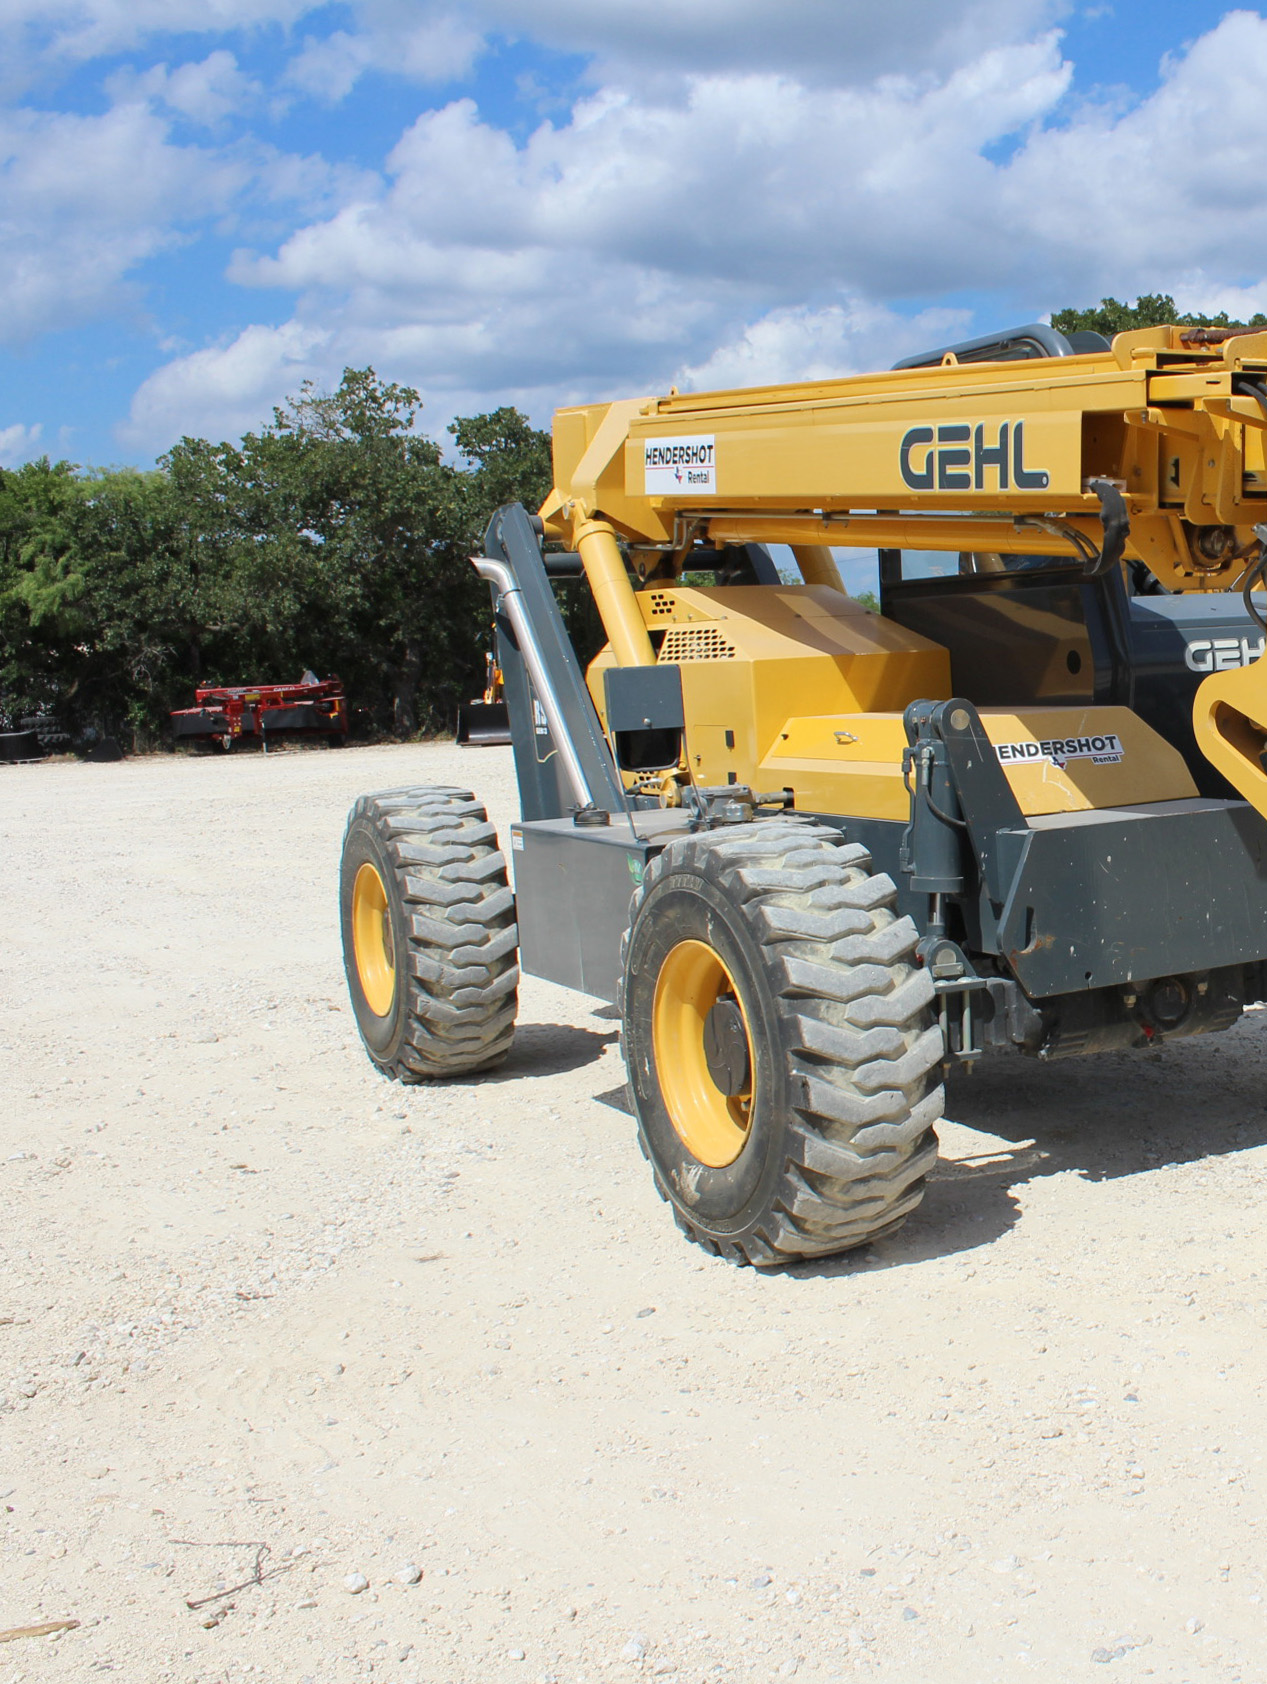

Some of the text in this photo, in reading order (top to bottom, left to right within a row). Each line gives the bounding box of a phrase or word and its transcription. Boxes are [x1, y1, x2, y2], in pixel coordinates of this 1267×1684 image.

[645, 445, 714, 465] HENDERSHOT
[900, 420, 1049, 490] GEHL
[688, 470, 709, 484] Rental
[1185, 637, 1266, 672] GEH
[994, 736, 1116, 759] ENDERSHOT
[1092, 755, 1120, 763] Rental
